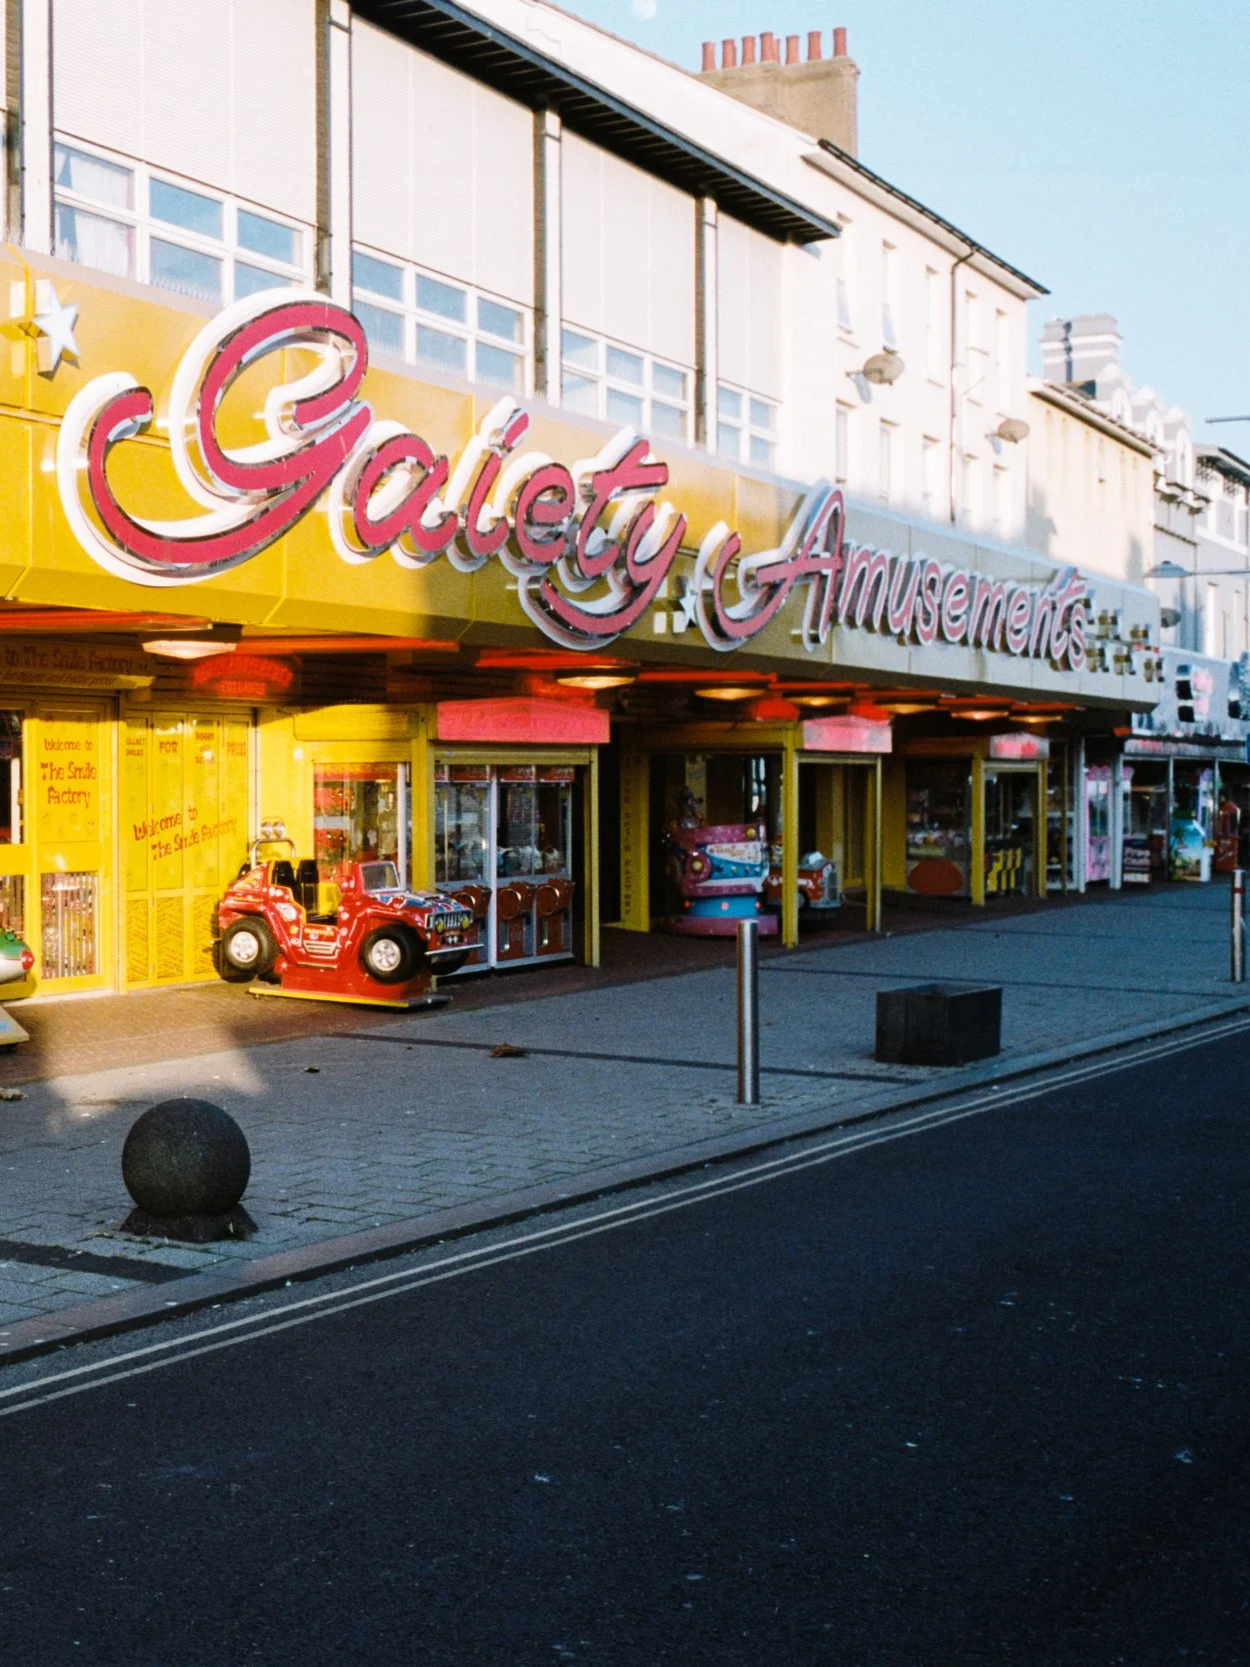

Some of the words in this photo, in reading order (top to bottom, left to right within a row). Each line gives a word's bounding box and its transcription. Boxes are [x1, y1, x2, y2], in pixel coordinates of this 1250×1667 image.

[72, 290, 688, 645] Gaiety
[705, 484, 1090, 672] Amusements
[44, 738, 81, 751] Welcome
[86, 740, 93, 751] to
[159, 741, 178, 753] FOR
[41, 761, 64, 781] The
[68, 761, 96, 780] Smile
[48, 785, 91, 809] Factory
[133, 812, 182, 841] Welcome
[188, 805, 198, 821] to
[151, 841, 172, 861] The
[174, 830, 200, 852] Smile
[201, 819, 237, 842] Factory
